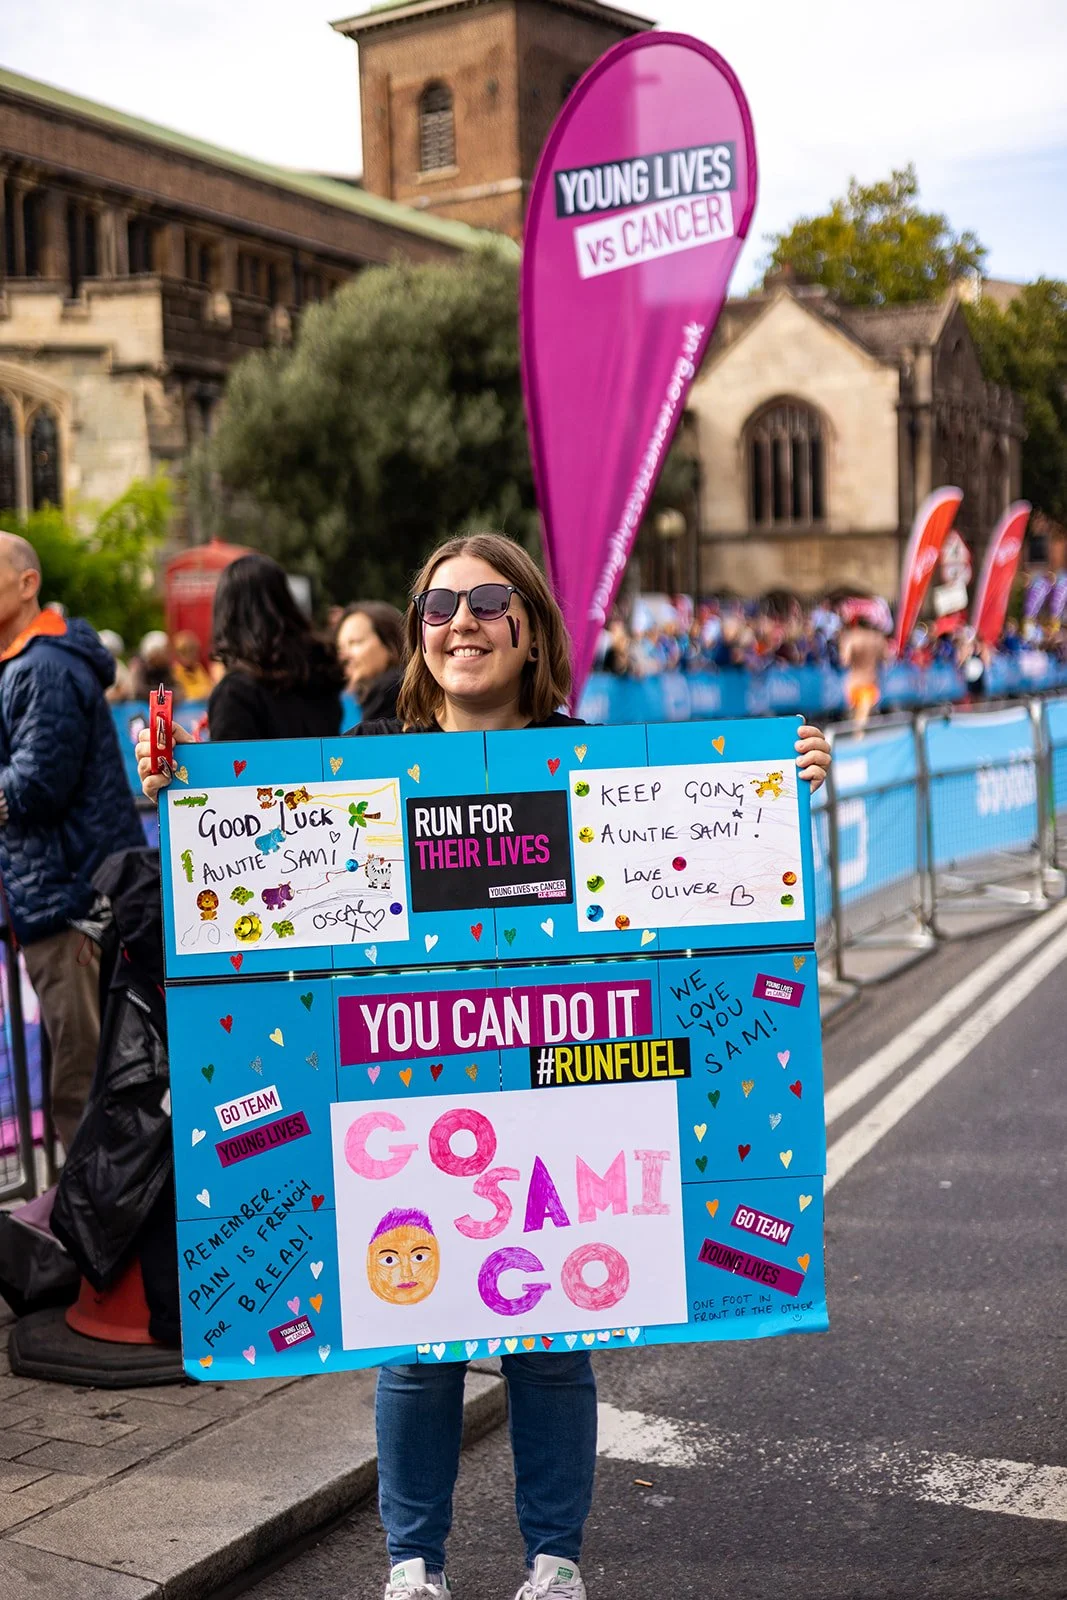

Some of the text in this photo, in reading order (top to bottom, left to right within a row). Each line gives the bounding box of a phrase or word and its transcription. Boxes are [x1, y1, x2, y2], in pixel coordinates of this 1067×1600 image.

[558, 145, 732, 214] YOUNG LIVES
[587, 196, 726, 266] vs CANCER
[601, 781, 744, 806] KEEP GOING
[198, 801, 334, 846] GOOD LUCK
[414, 803, 515, 837] RUN FOR
[601, 823, 678, 844] AUNTIE
[690, 821, 738, 840] SAMI
[202, 853, 267, 885] AUNTIE
[280, 848, 336, 874] SAMI
[414, 834, 550, 870] THEIR LIVES
[490, 887, 512, 897] YOUNG
[513, 884, 531, 895] LIVES
[540, 880, 565, 891] CANCER
[652, 882, 719, 899] OLIVER
[313, 900, 372, 929] OSCAR
[669, 969, 707, 1001] WE
[359, 988, 640, 1054] YOU CAN DO IT
[676, 981, 730, 1029] LOVE
[699, 998, 743, 1037] YOU
[536, 1040, 685, 1086] #RUNFUEL
[220, 1090, 278, 1125] GO TEAM
[220, 1117, 304, 1160] YOUNG LIVES
[344, 1107, 497, 1180] GO
[454, 1149, 671, 1240] SAMI
[735, 1208, 791, 1242] GO TEAM
[188, 1180, 312, 1310] PAIN IS FRENCH
[702, 1242, 780, 1285] YOUNG LIVES
[477, 1242, 630, 1316] GO
[693, 1294, 771, 1311] ONE FOOT IN
[694, 1300, 814, 1323] FRONT OF THE OTHER
[204, 1320, 232, 1348] FOR
